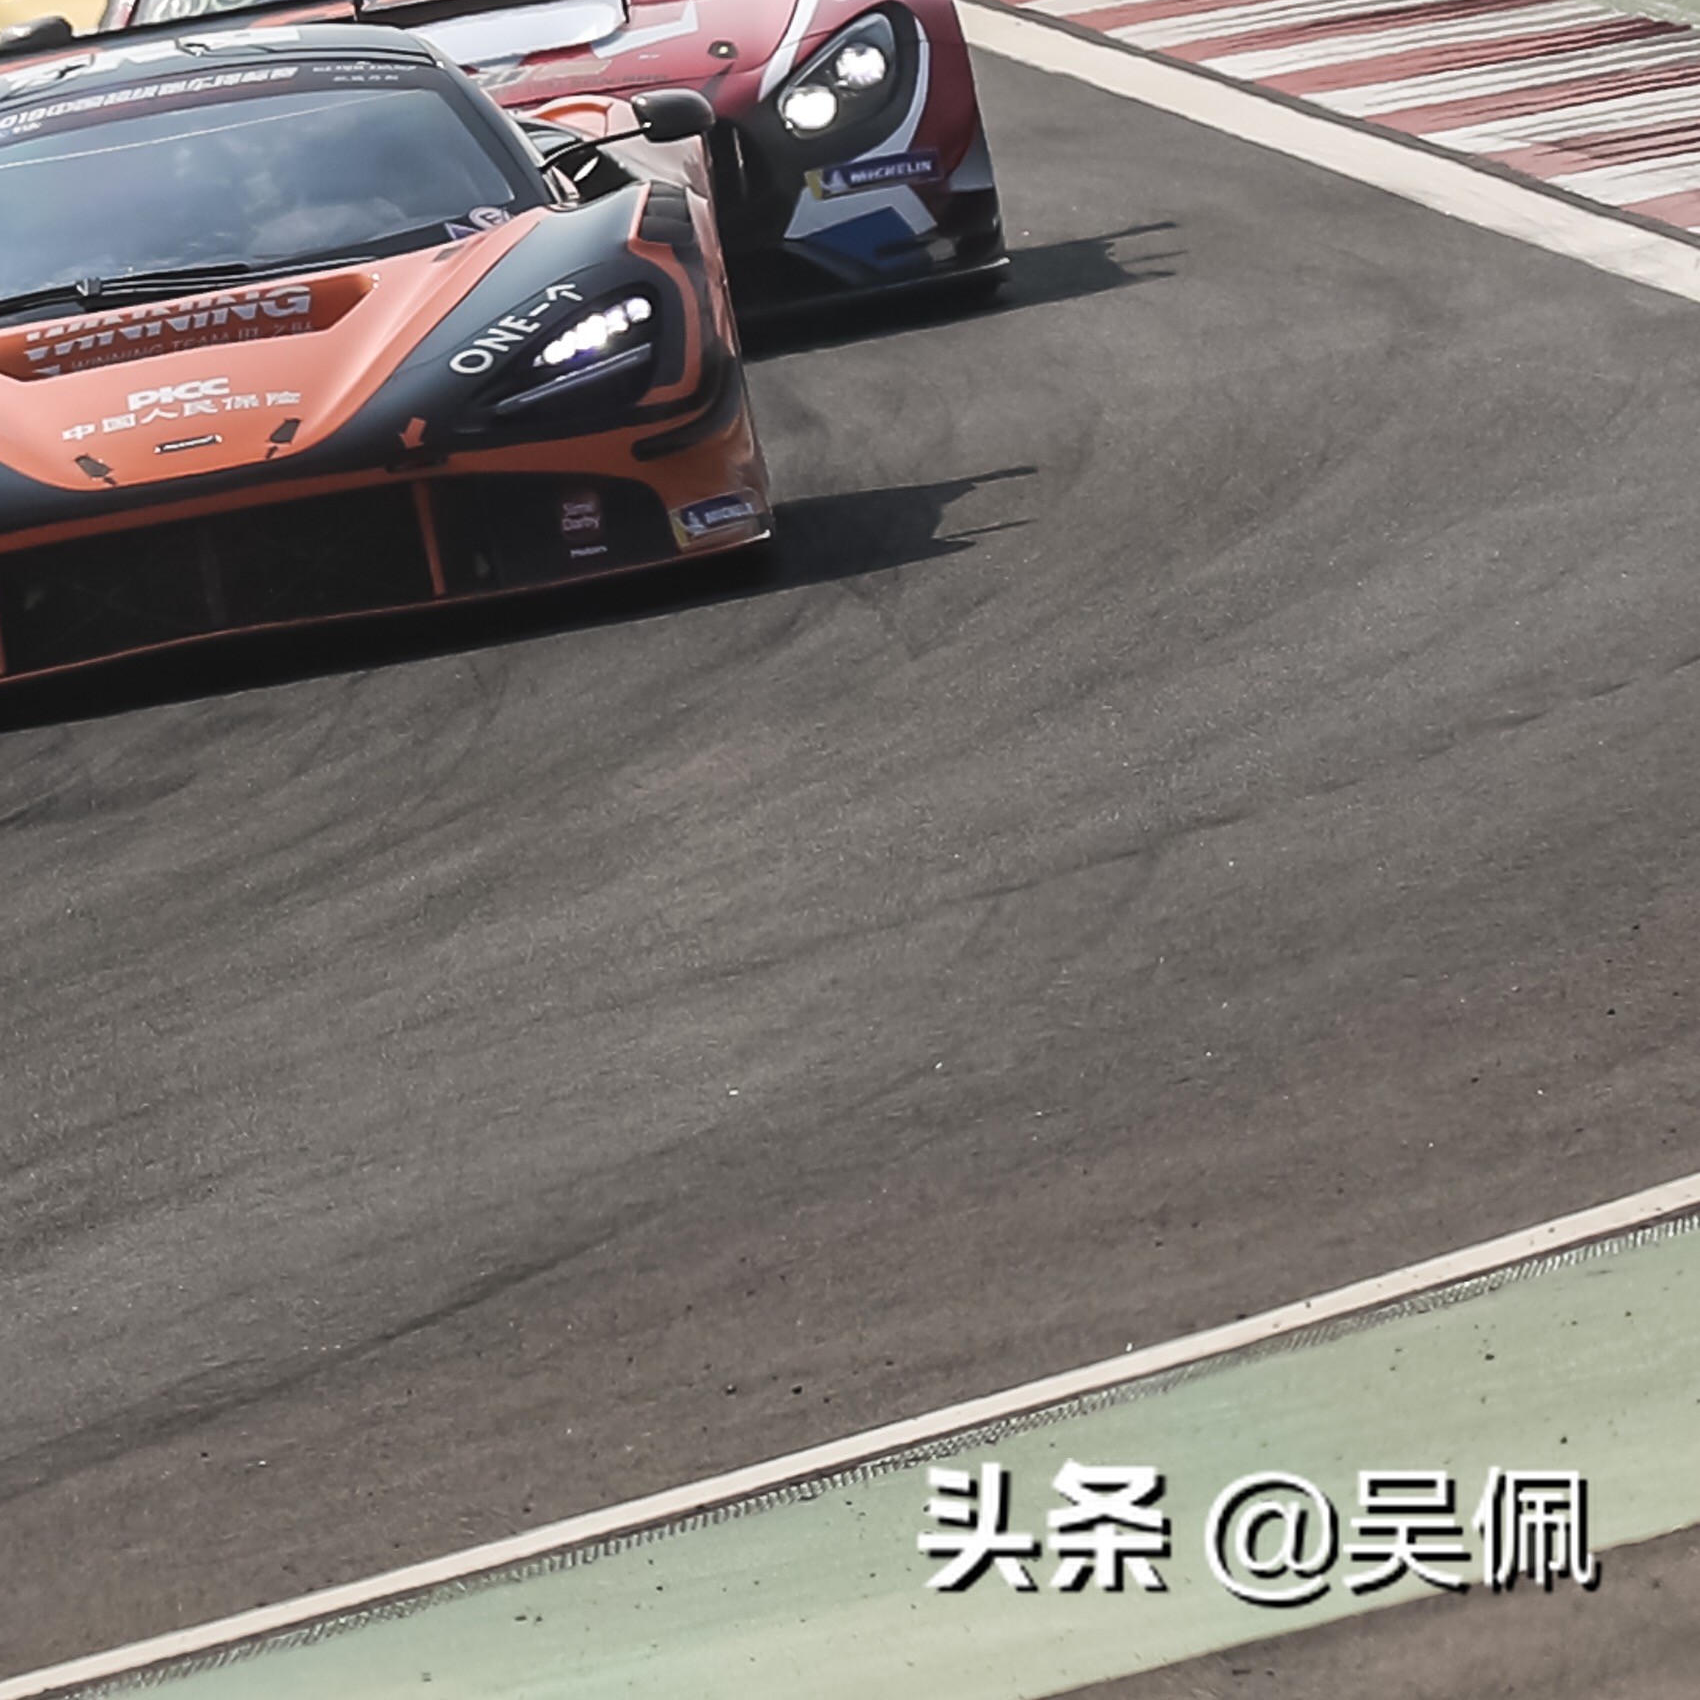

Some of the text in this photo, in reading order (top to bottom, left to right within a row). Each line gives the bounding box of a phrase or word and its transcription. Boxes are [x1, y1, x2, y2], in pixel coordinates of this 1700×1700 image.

[126, 377, 231, 411] PICC
[60, 390, 302, 442] 中国人民保险
